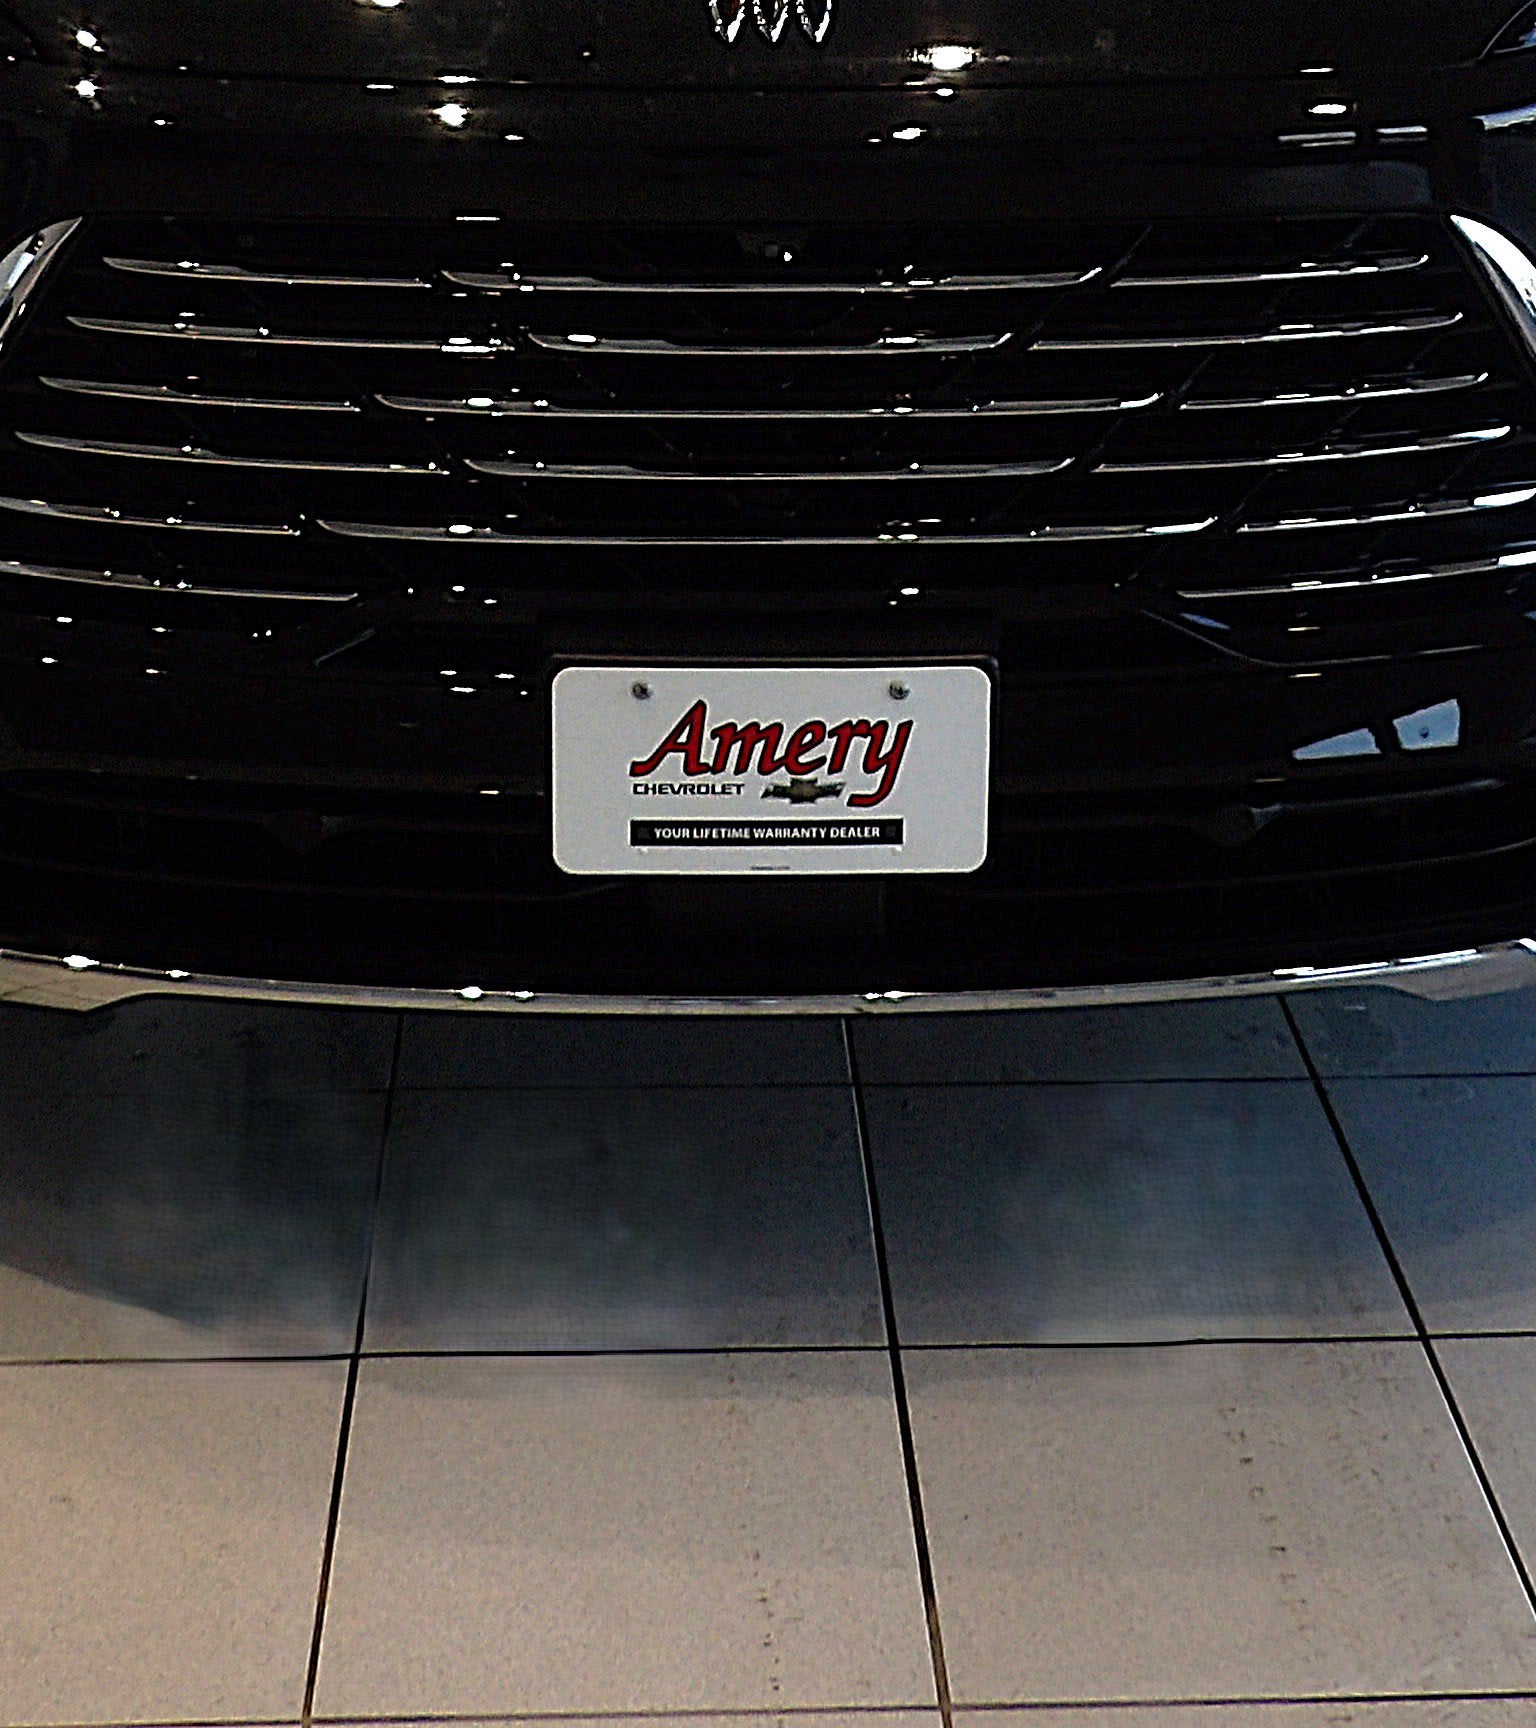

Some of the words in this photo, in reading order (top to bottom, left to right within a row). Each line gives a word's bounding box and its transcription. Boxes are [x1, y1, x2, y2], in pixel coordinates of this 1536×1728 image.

[628, 698, 914, 808] Amery
[632, 783, 745, 795] CHEVROLET
[654, 827, 690, 839] YOUR
[693, 827, 750, 839] LIFETIME
[753, 826, 827, 839] WARRANTY
[830, 826, 881, 838] DEALER
